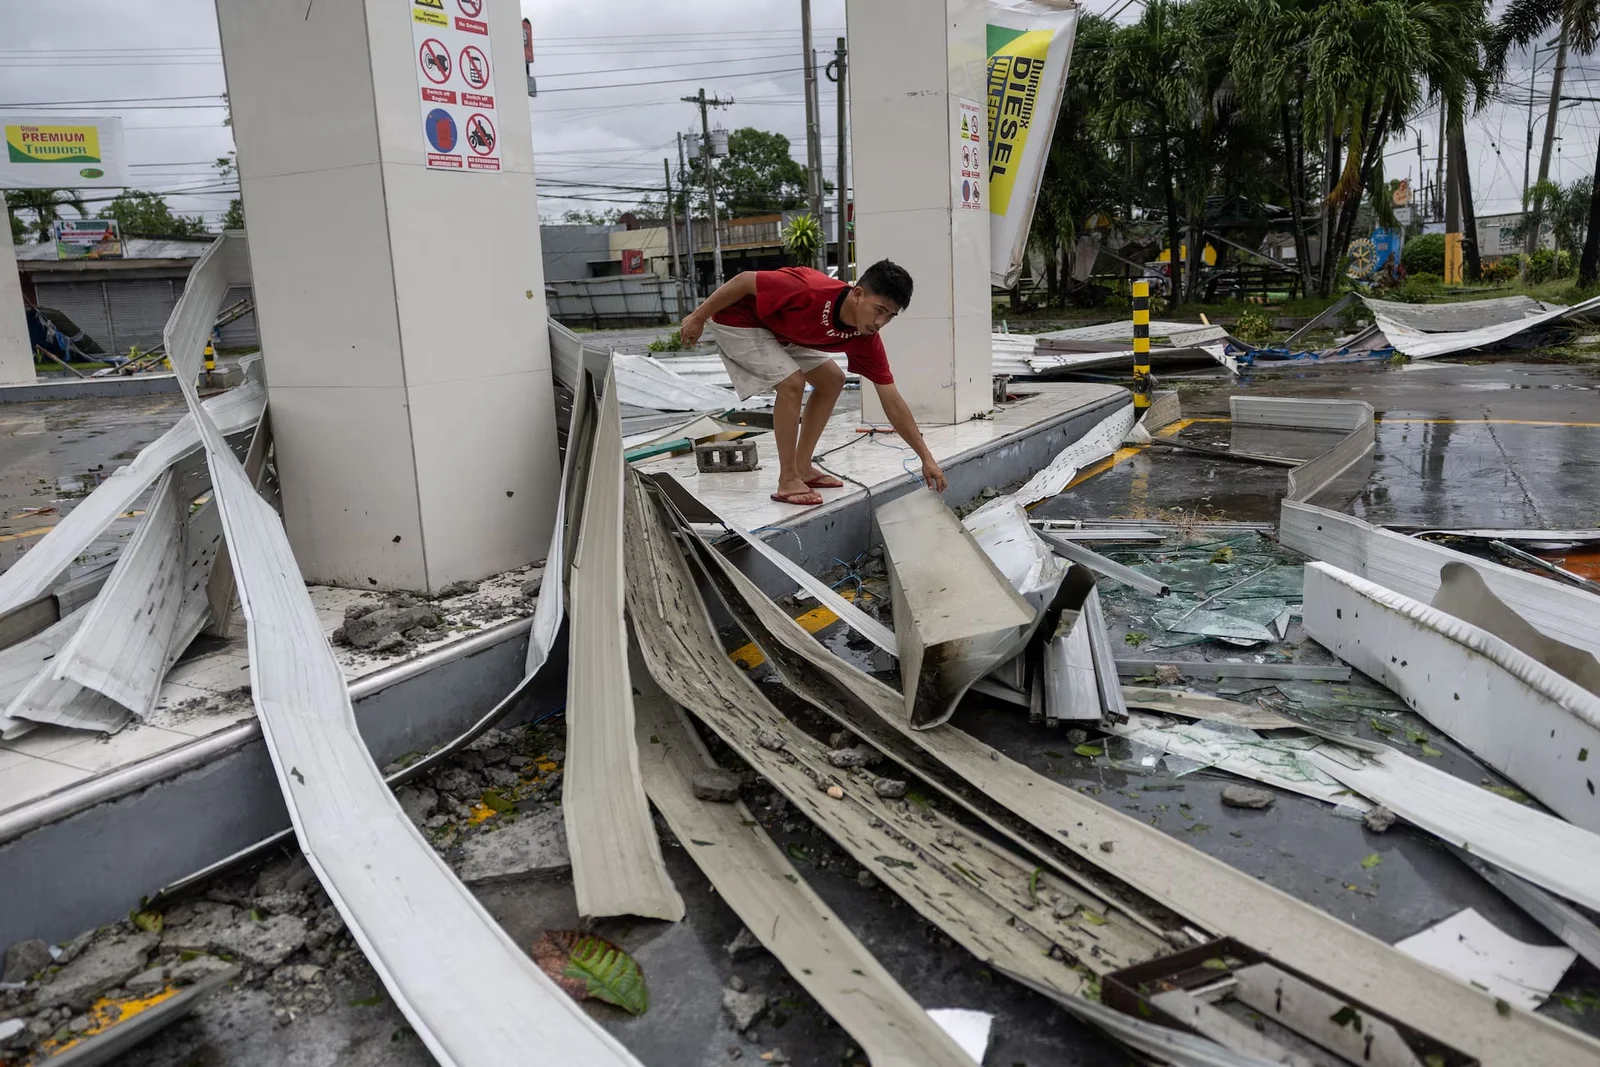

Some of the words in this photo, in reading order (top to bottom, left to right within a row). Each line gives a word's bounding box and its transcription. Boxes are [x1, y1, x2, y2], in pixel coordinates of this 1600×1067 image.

[466, 23, 485, 32] Smoking
[1019, 59, 1045, 129] DURAMAX
[989, 56, 1032, 183] DIESEL
[22, 132, 85, 142] PREMIUM
[24, 144, 87, 154] THUNDER
